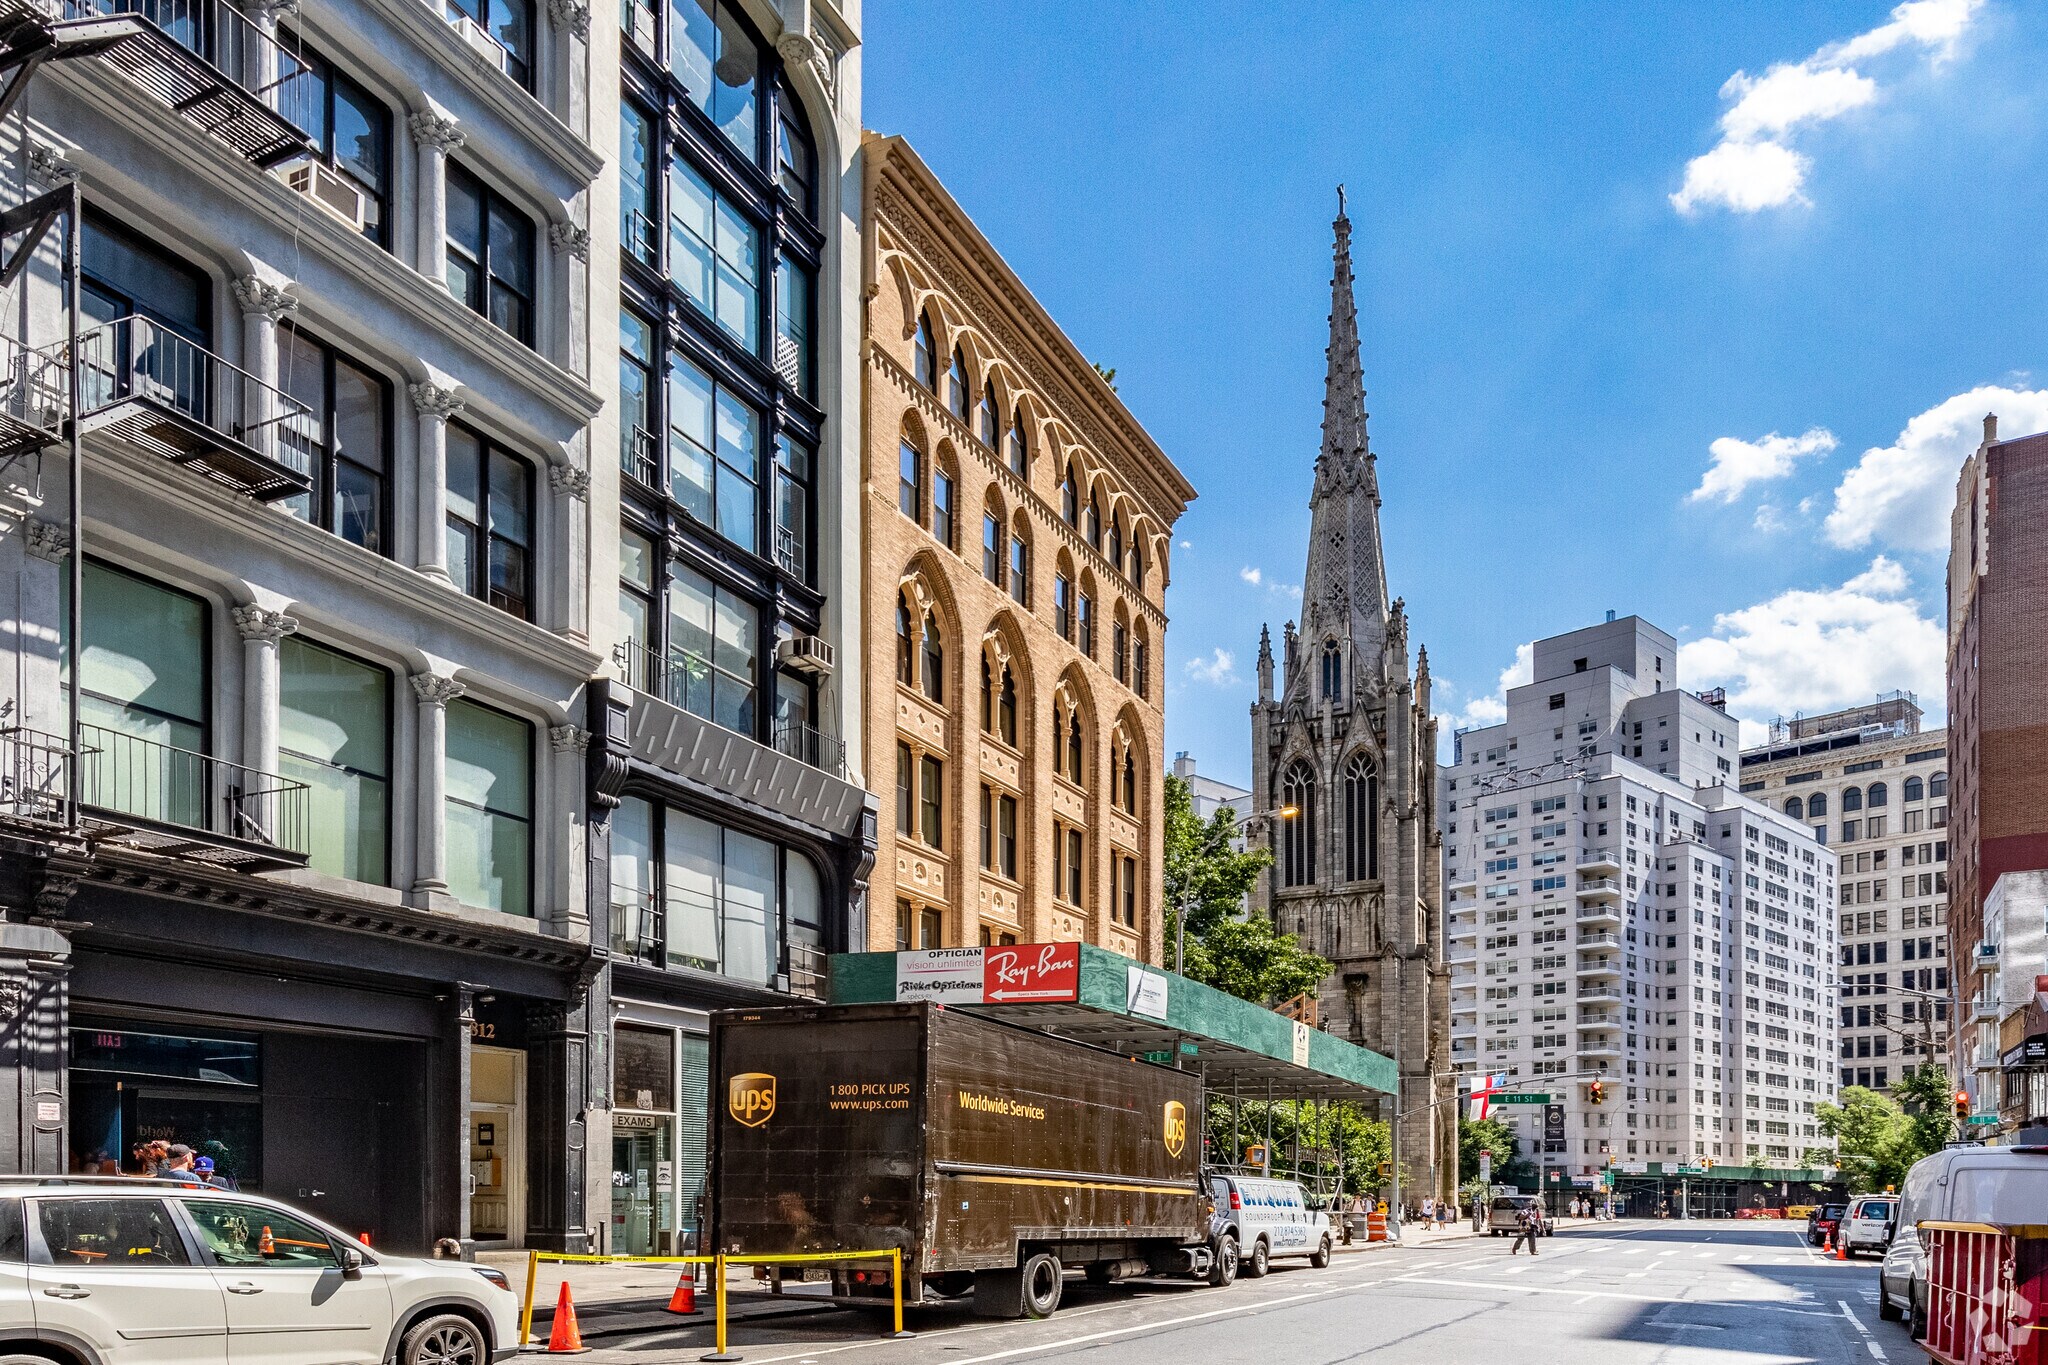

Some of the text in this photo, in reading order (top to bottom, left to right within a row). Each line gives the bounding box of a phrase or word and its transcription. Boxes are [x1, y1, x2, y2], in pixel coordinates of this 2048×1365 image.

[928, 949, 982, 958] OPTICIAN
[906, 959, 982, 970] vision unlimited
[471, 1022, 495, 1039] 812
[829, 1083, 910, 1096] 1 800 PICK UPS
[733, 1089, 773, 1119] ups
[830, 1100, 909, 1112] www.ups.com
[959, 1090, 1045, 1120] Worldwide Services
[618, 1116, 652, 1127] EXAMS
[1166, 1117, 1184, 1149] ups
